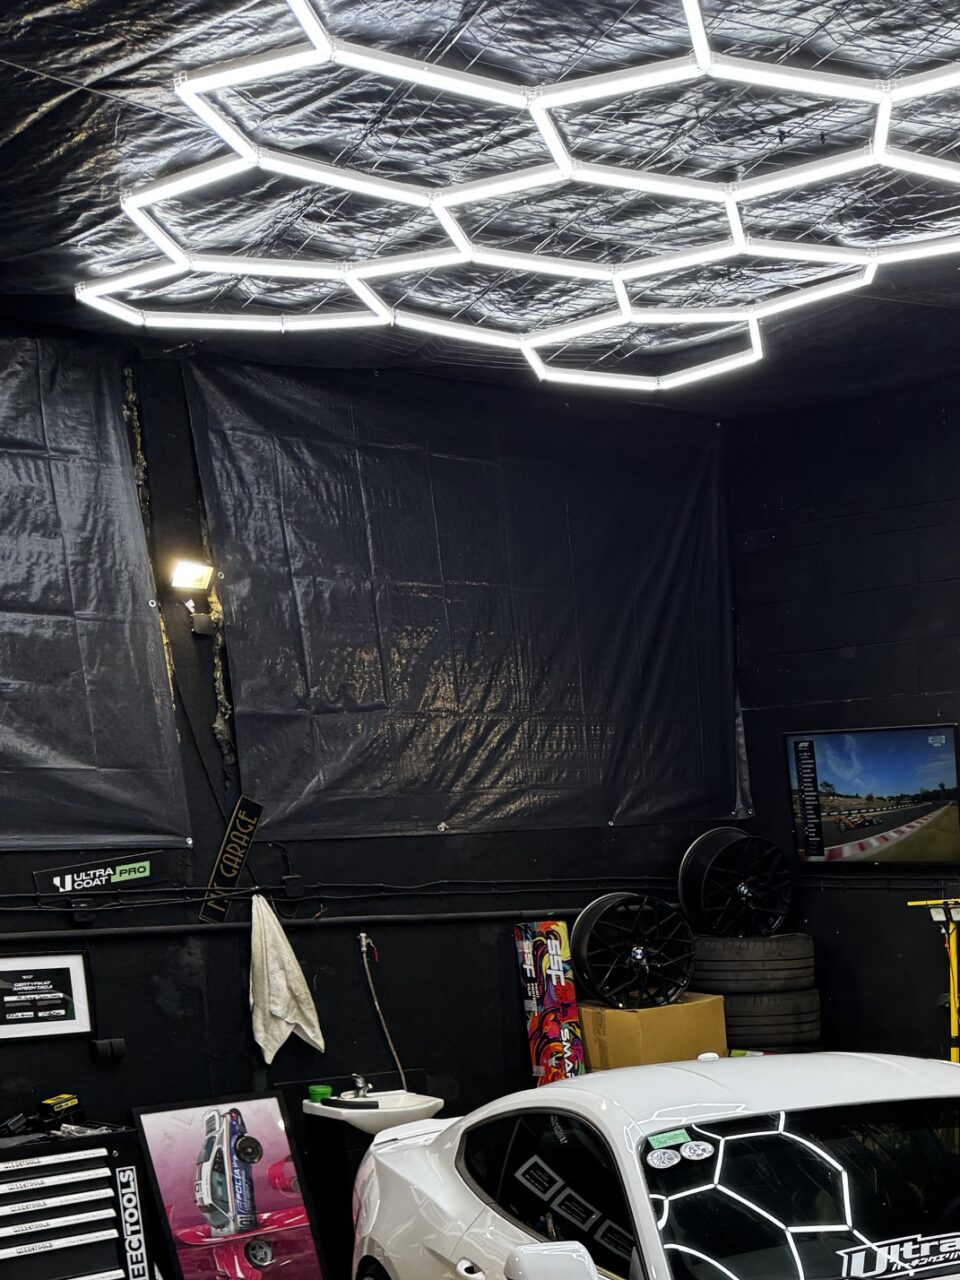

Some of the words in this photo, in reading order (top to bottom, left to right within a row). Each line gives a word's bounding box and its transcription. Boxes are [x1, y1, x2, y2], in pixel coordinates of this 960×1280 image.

[220, 809, 258, 878] GARAGE
[73, 867, 114, 881] ULTRA
[119, 865, 147, 877] PRO
[73, 876, 108, 890] COAT
[523, 940, 536, 978] SSF
[547, 938, 566, 987] SSF
